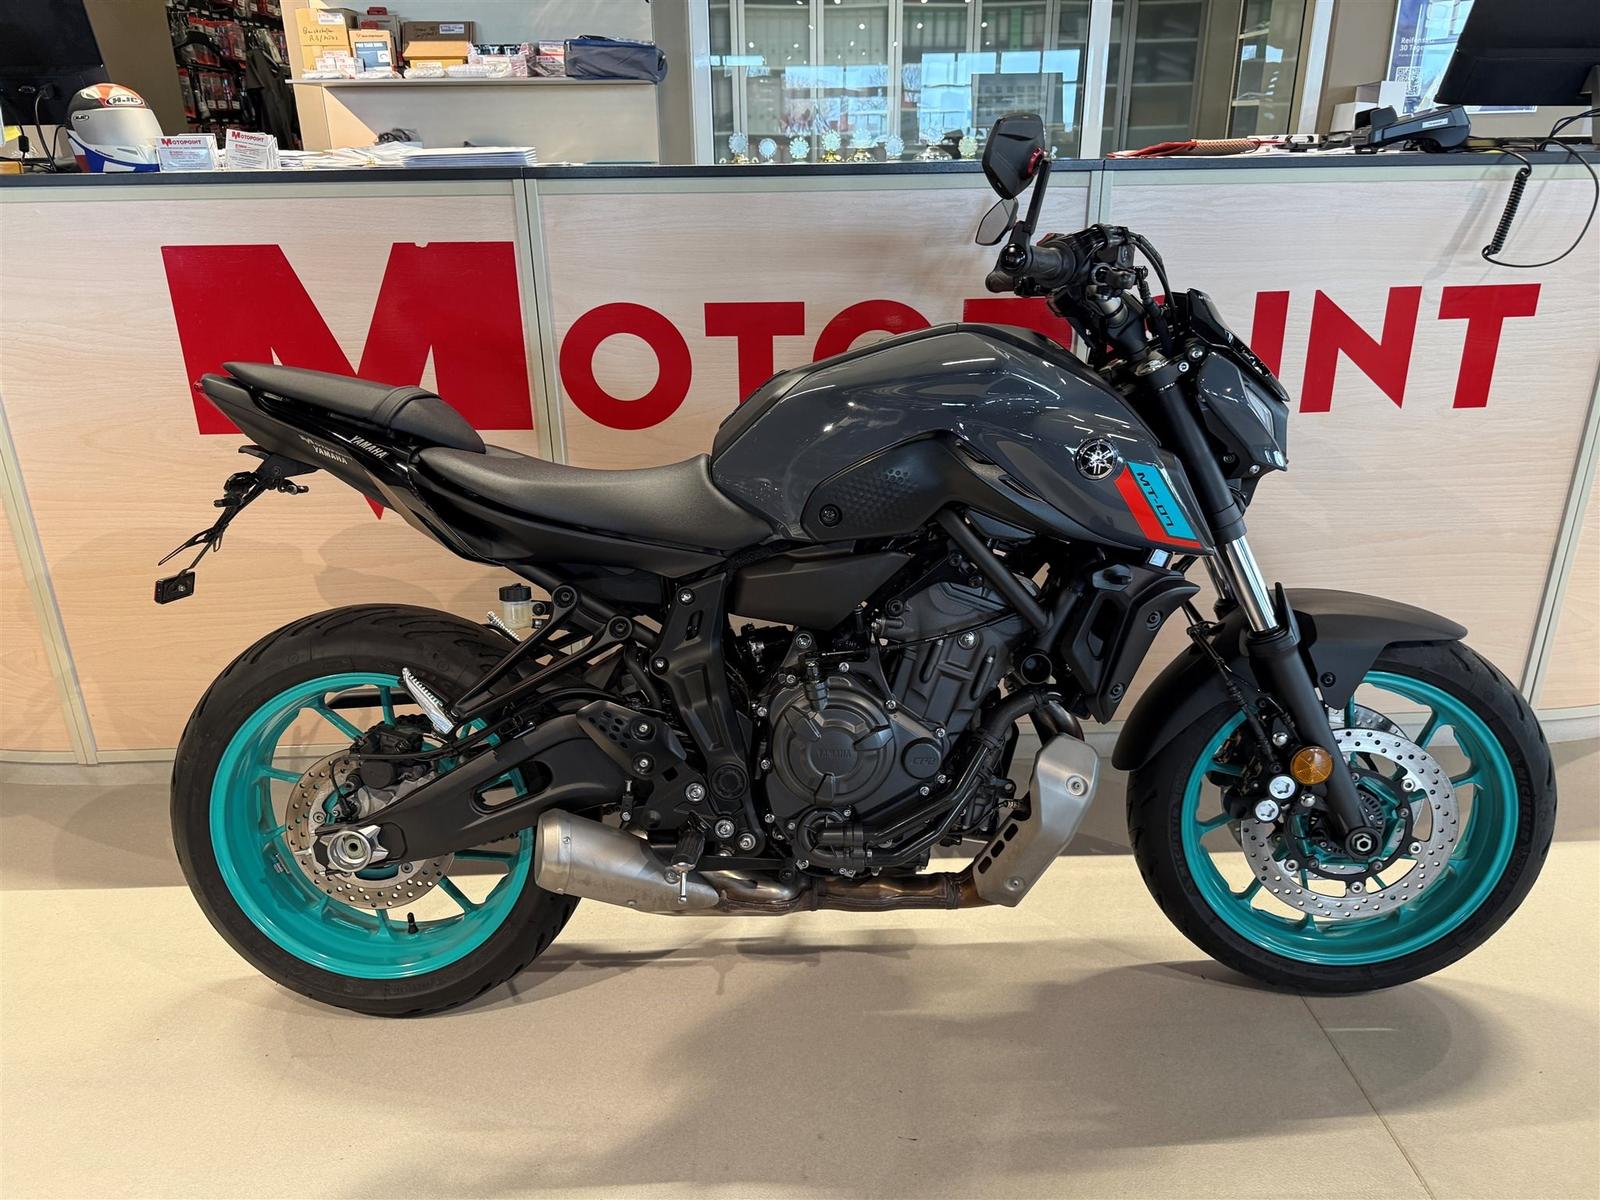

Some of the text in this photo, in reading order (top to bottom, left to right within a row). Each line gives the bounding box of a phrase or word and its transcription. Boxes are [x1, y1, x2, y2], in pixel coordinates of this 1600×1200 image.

[161, 138, 202, 147] MOTOPOINT
[230, 130, 265, 143] MOTOPOINT
[161, 238, 1541, 519] MOTINT
[312, 444, 348, 465] YAMAHA
[350, 434, 389, 459] YAMAHA
[1136, 471, 1175, 527] MT-07
